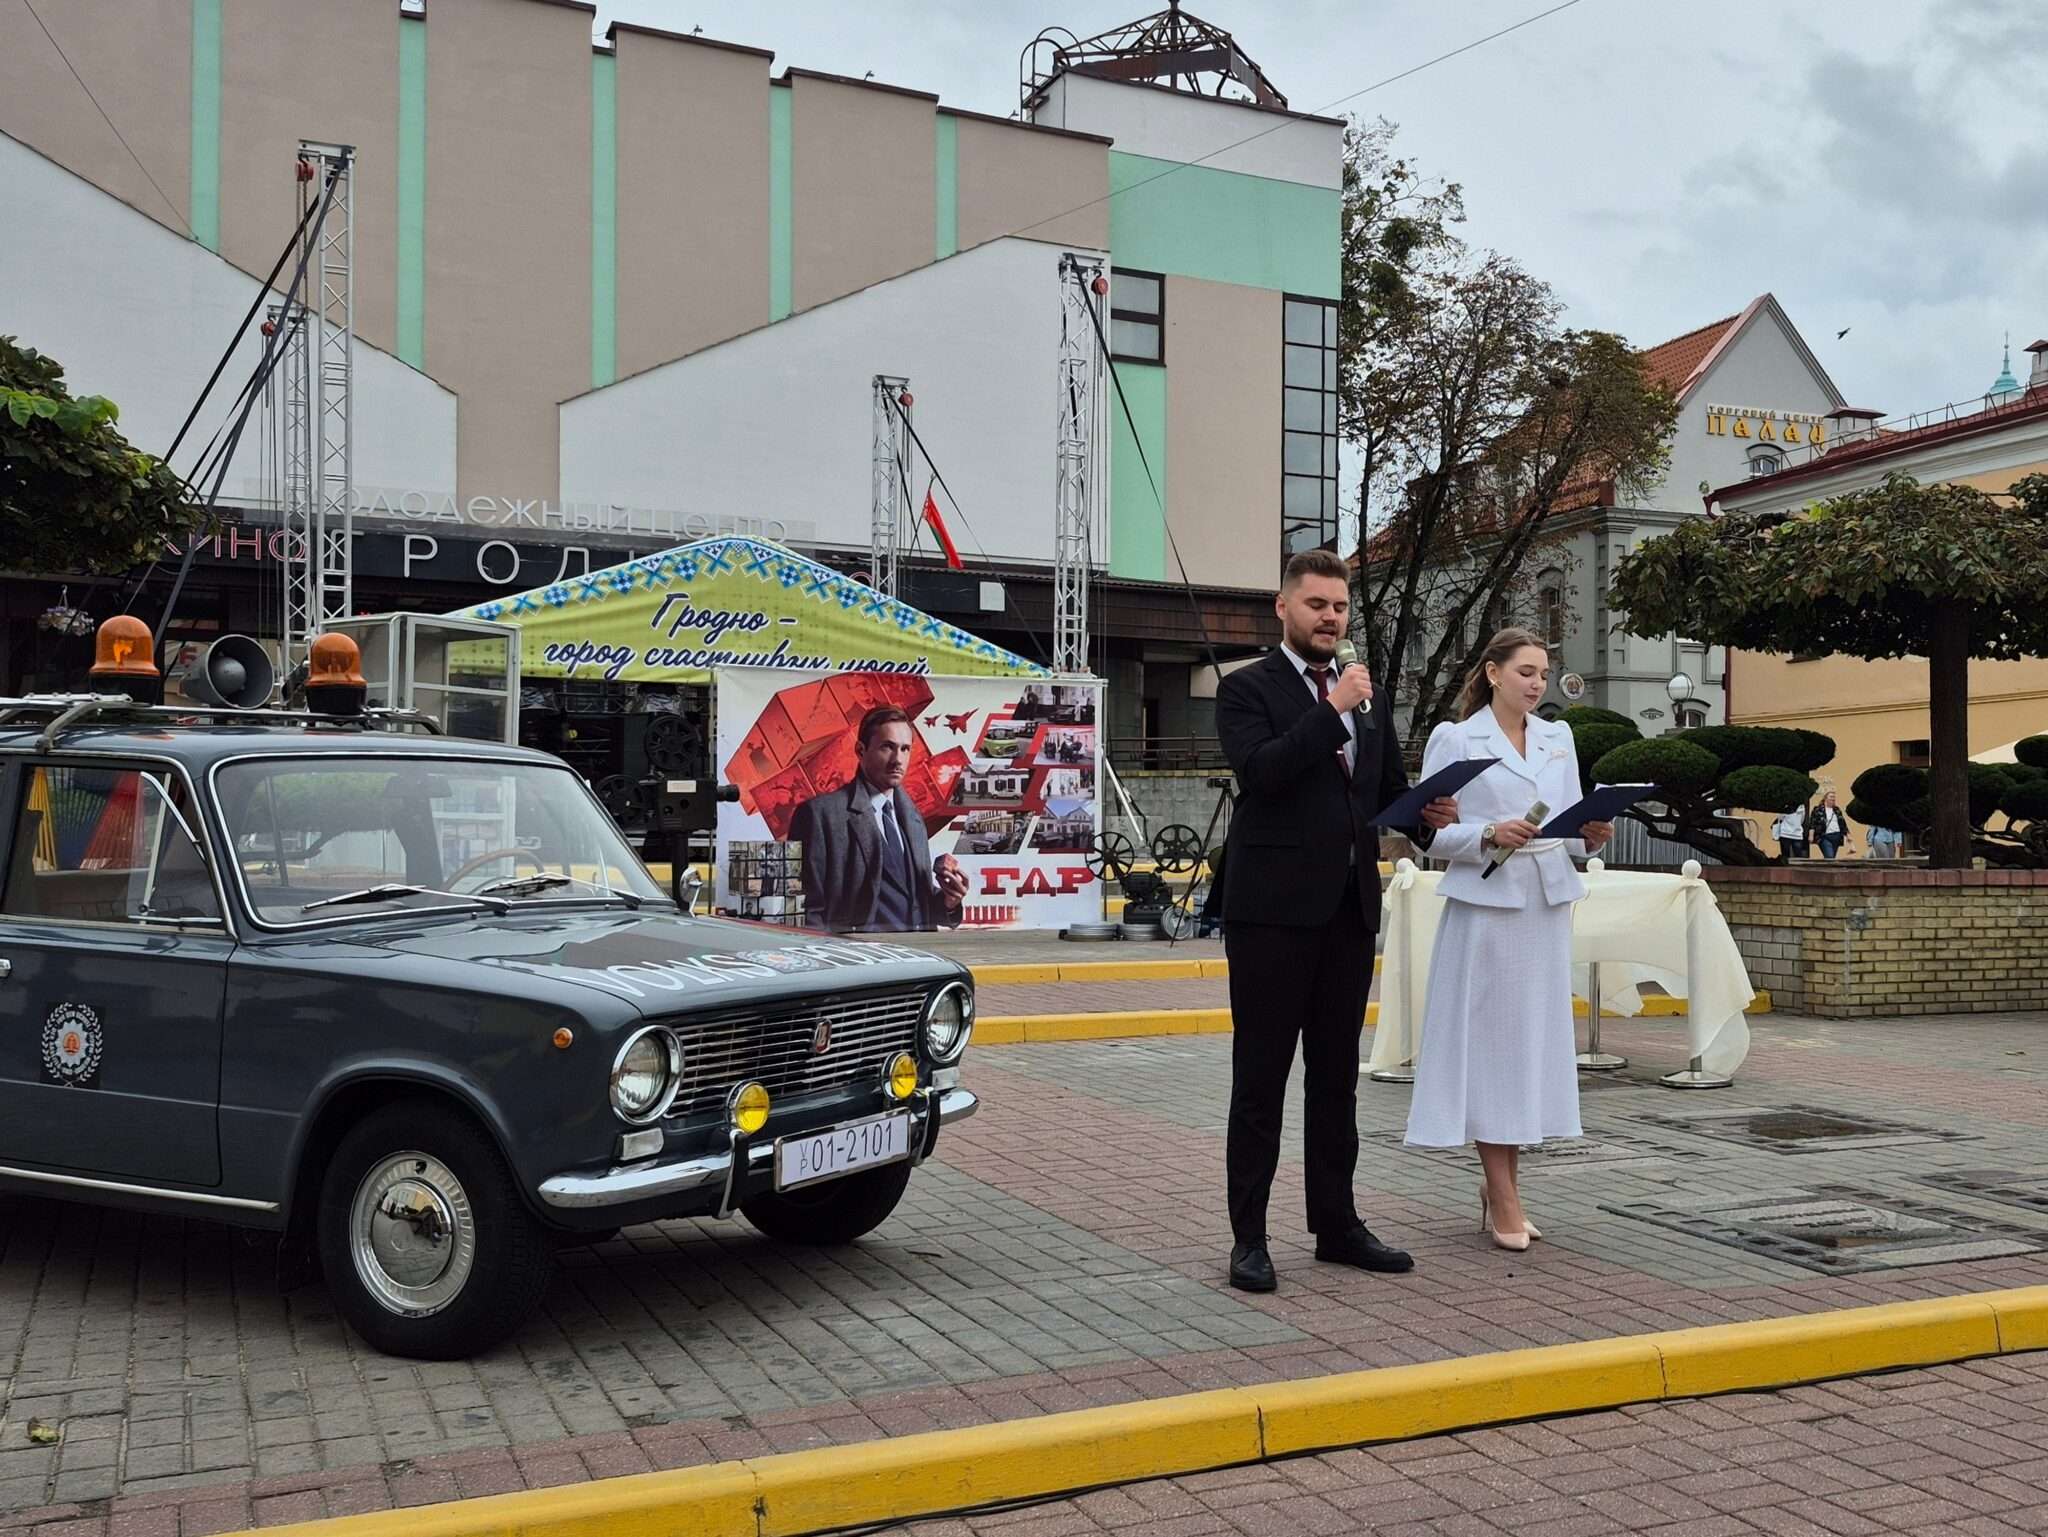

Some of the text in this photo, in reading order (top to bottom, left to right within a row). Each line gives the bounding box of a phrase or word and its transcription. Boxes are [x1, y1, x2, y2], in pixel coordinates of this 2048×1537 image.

[1706, 414, 1826, 450] ПАЛАЦ
[329, 529, 635, 584] ГРОД
[652, 592, 769, 645] Гродно
[544, 638, 637, 680] город
[980, 867, 1095, 898] ГДР
[811, 1119, 893, 1173] 01-2101
